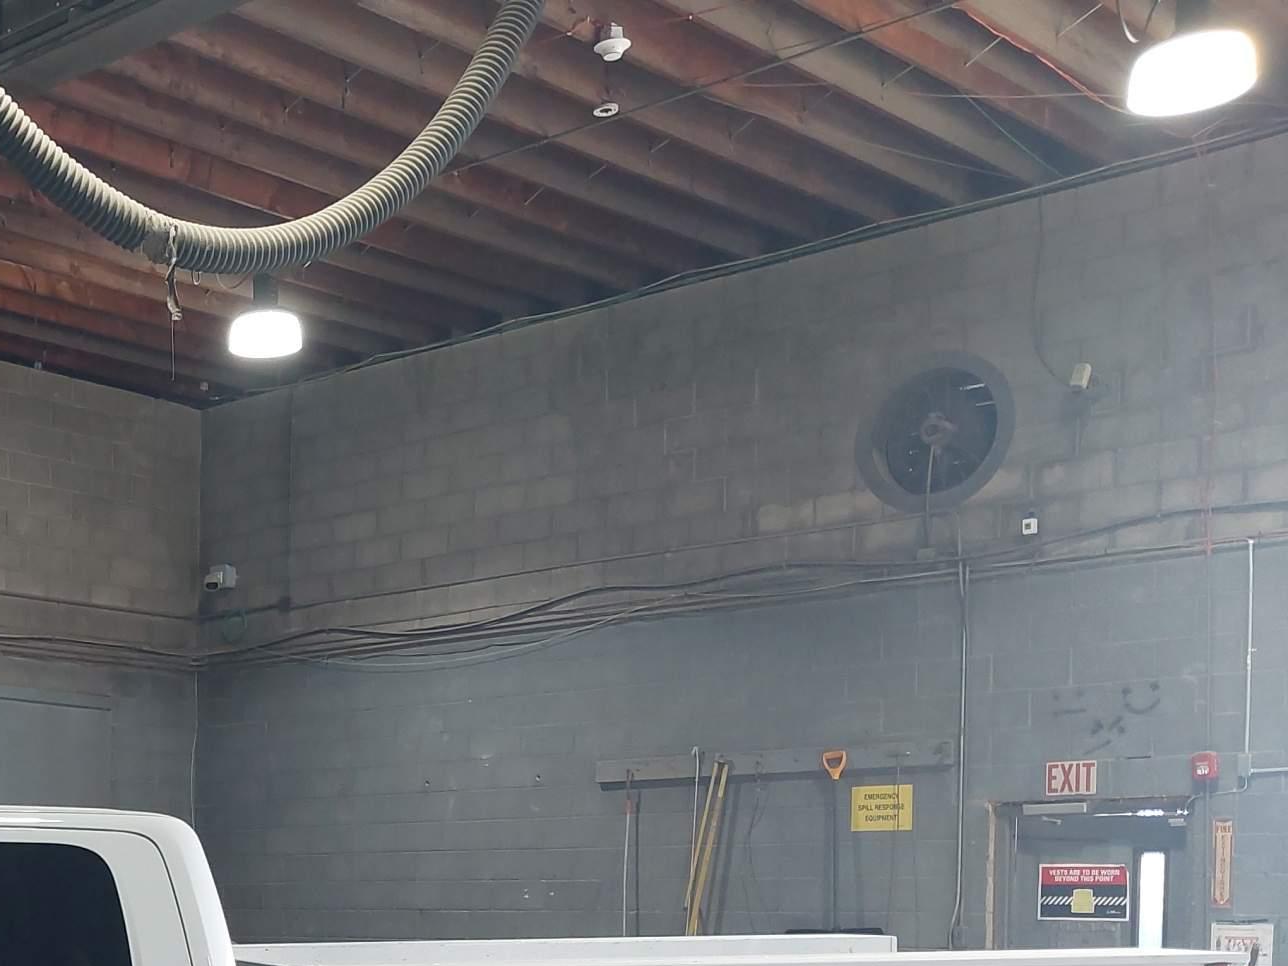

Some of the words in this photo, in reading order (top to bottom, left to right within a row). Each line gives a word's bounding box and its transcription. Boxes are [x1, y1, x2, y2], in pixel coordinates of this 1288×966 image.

[1047, 762, 1096, 793] EXIT
[864, 793, 899, 801] EMERGENCY
[865, 814, 897, 822] EQUIPMENT
